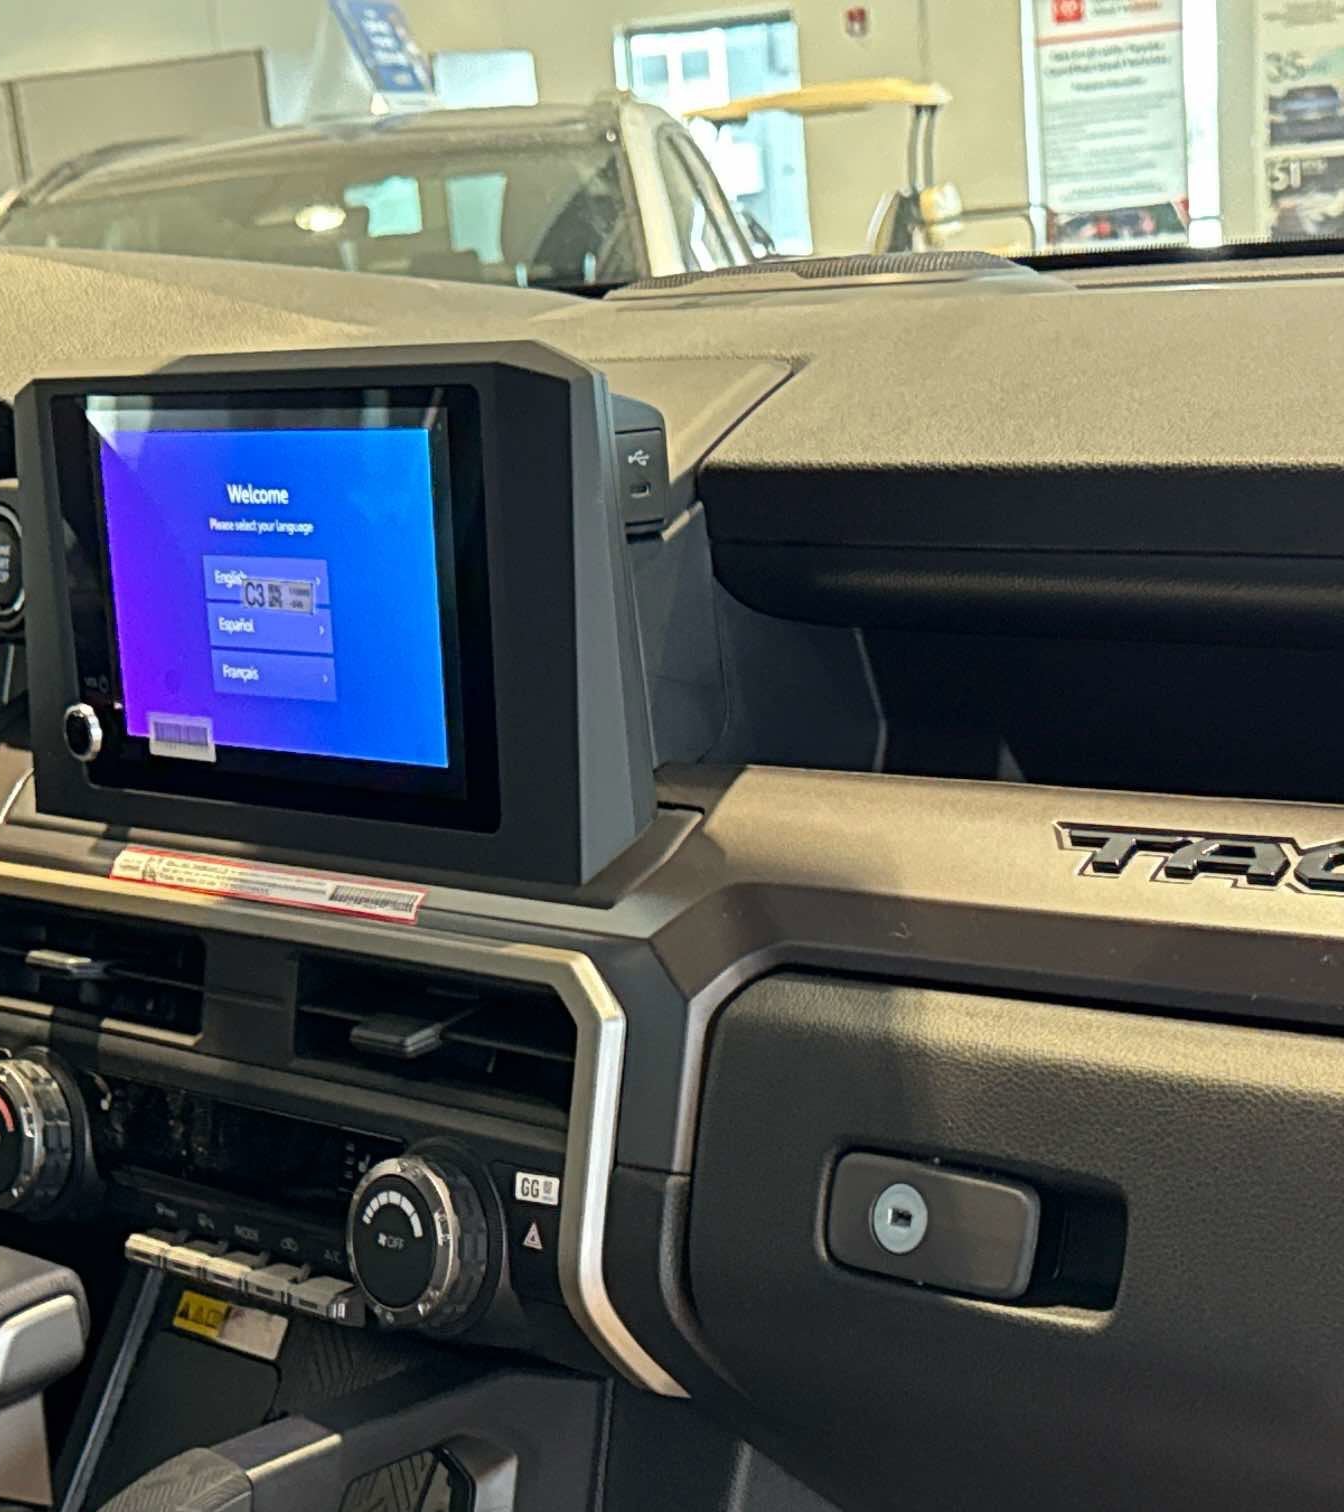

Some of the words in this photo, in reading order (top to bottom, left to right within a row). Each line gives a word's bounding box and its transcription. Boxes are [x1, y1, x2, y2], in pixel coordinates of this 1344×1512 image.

[226, 483, 289, 504] Welcome
[209, 517, 234, 531] Please
[235, 518, 256, 531] select
[257, 520, 274, 534] your
[276, 519, 314, 535] language
[244, 582, 265, 608] C3
[218, 616, 255, 634] Español
[222, 663, 259, 683] Français
[520, 1177, 540, 1198] GG
